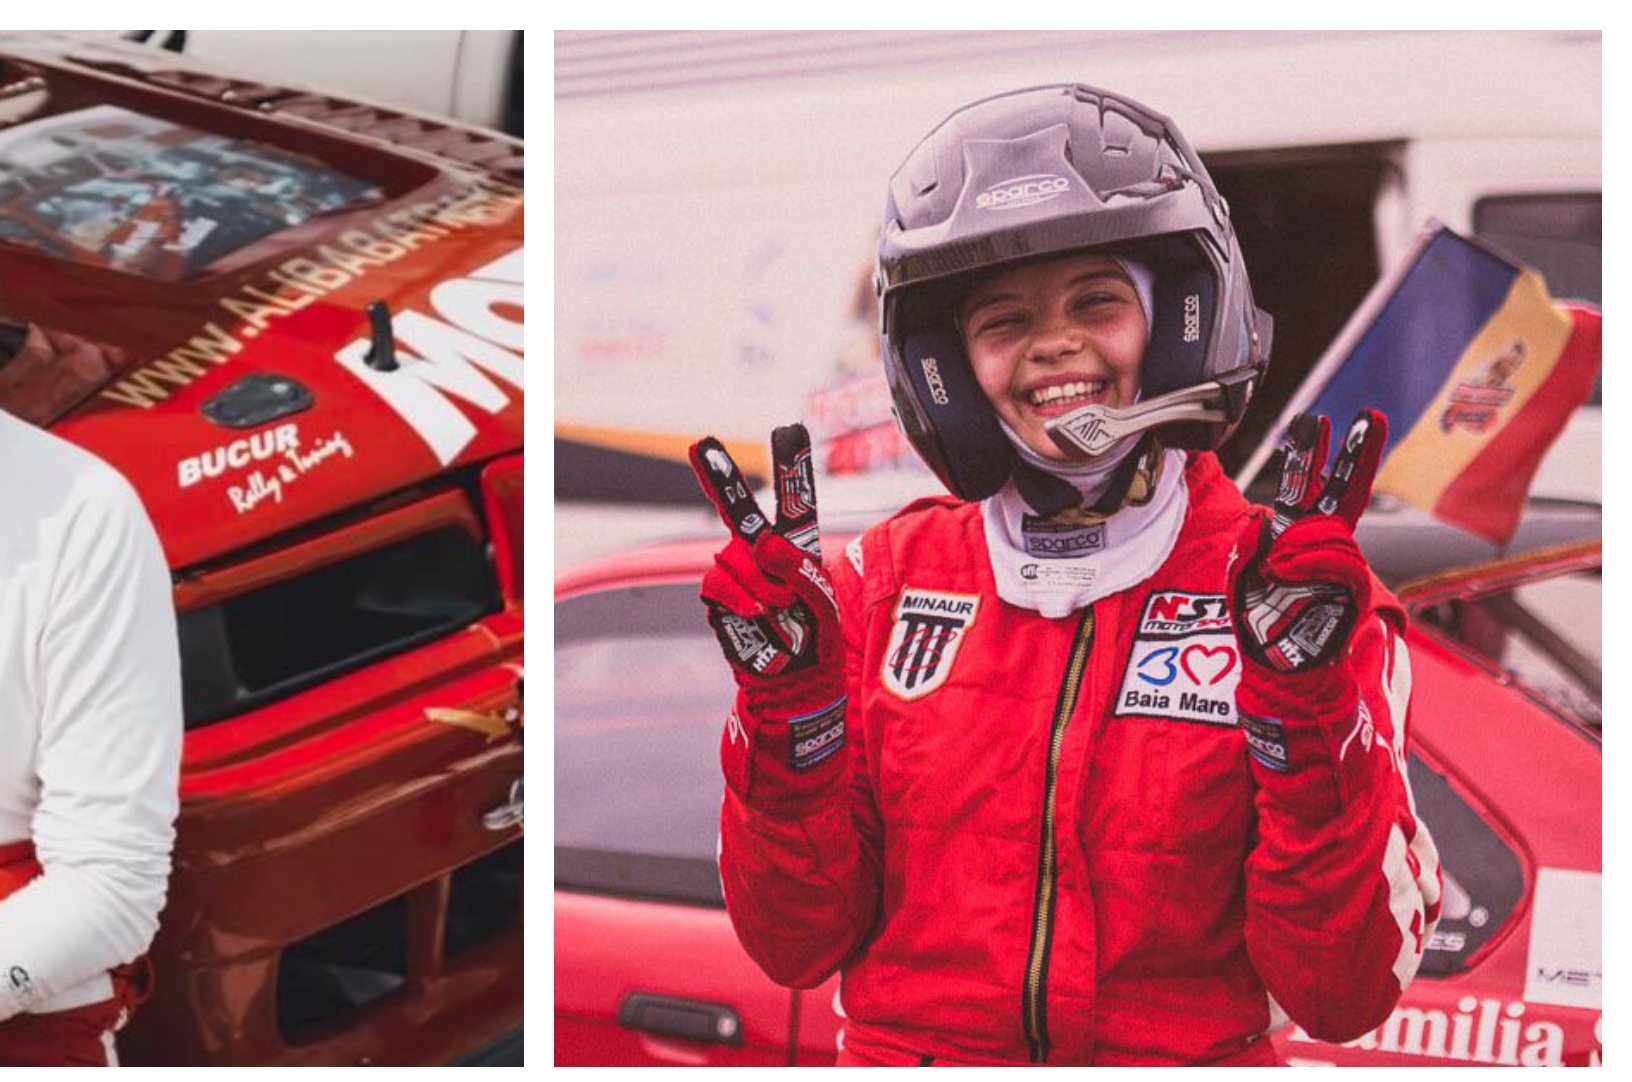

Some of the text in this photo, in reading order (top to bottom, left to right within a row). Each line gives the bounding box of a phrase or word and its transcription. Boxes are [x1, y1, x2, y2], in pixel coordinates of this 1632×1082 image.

[976, 177, 1070, 209] sparco
[1183, 293, 1200, 342] sparco
[920, 357, 949, 405] sparco
[177, 422, 300, 488] BUCUR
[226, 470, 283, 514] Rally
[1028, 532, 1101, 553] sparco
[902, 596, 974, 615] MINAUR
[1124, 689, 1230, 716] Baia Mare
[795, 721, 844, 758] sparco
